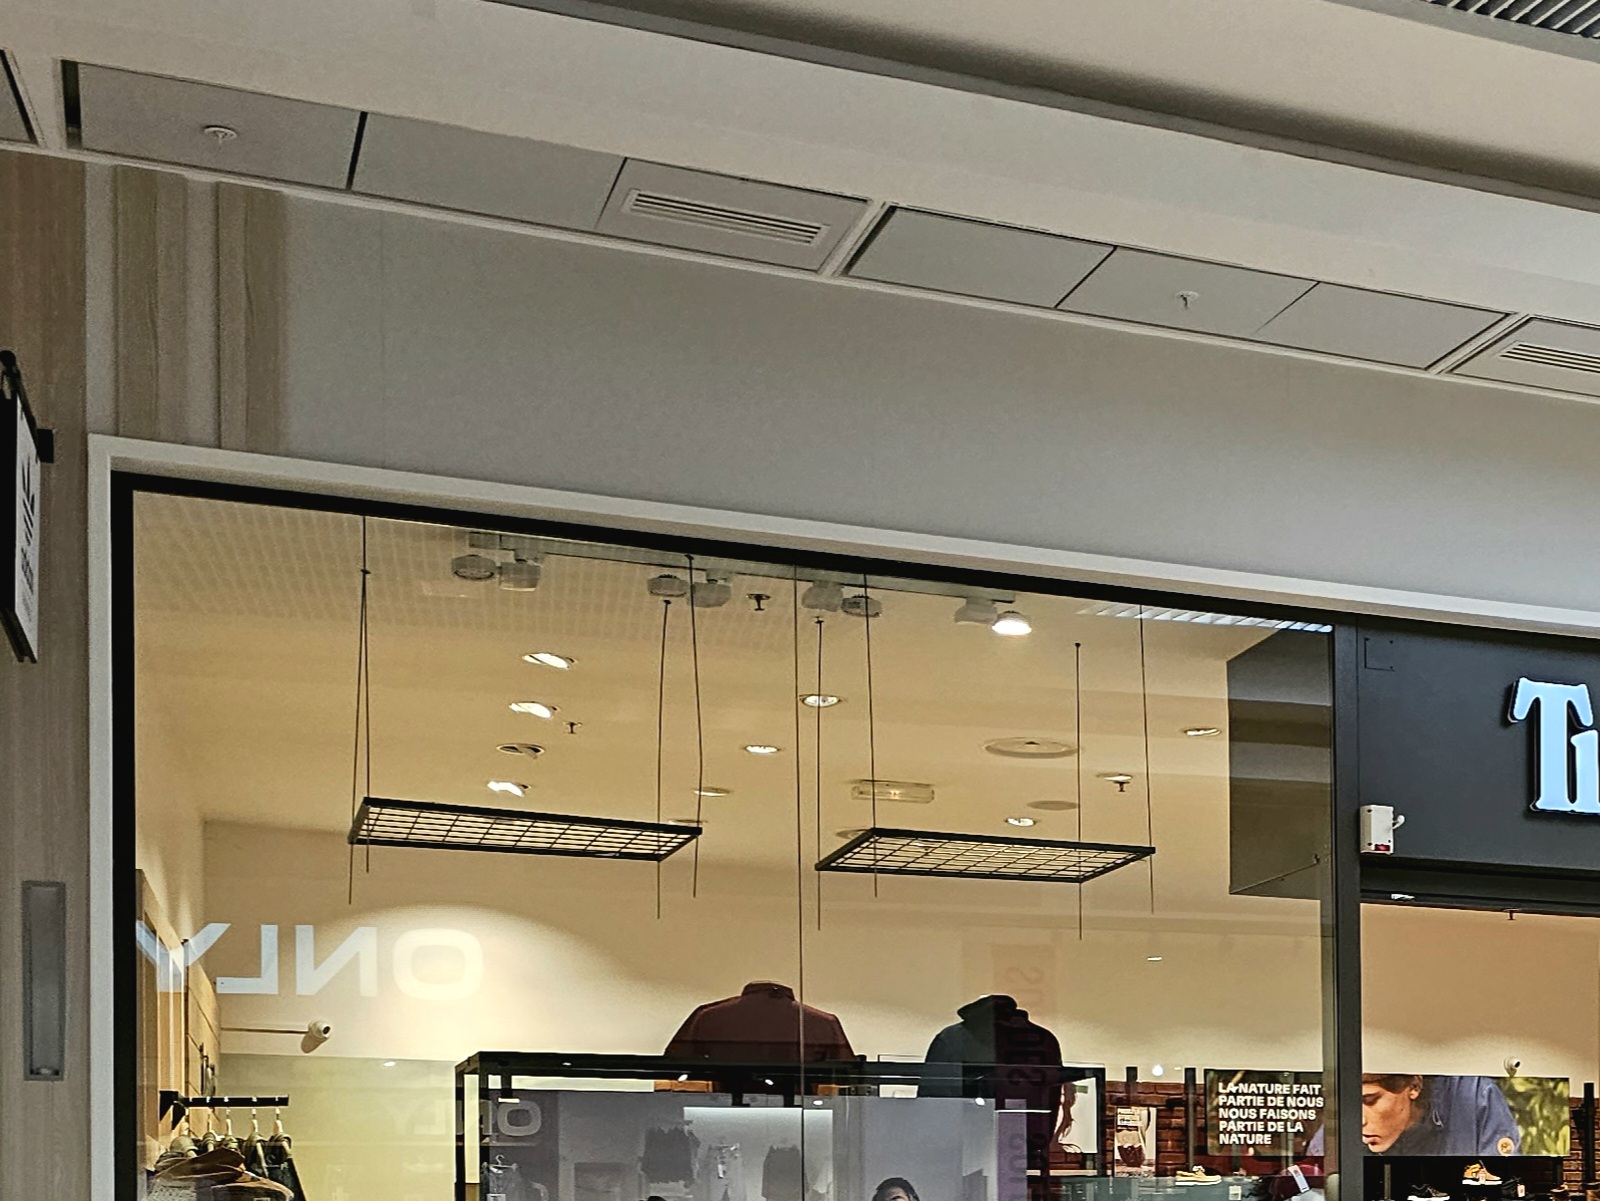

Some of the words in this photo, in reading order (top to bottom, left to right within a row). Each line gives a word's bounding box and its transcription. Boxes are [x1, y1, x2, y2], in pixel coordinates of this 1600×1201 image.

[1218, 1083, 1237, 1094] LA
[1239, 1083, 1290, 1094] NATURE
[1292, 1084, 1322, 1095] FAIT
[1218, 1095, 1265, 1107] PARTIE
[1267, 1096, 1285, 1107] DE
[1286, 1096, 1324, 1108] NOUS
[1218, 1108, 1257, 1119] NOUS
[1259, 1108, 1317, 1121] FAISONS
[1219, 1120, 1265, 1132] PARTIE
[1267, 1121, 1284, 1132] DE
[1286, 1121, 1303, 1133] LA
[1219, 1133, 1272, 1145] NATURE
